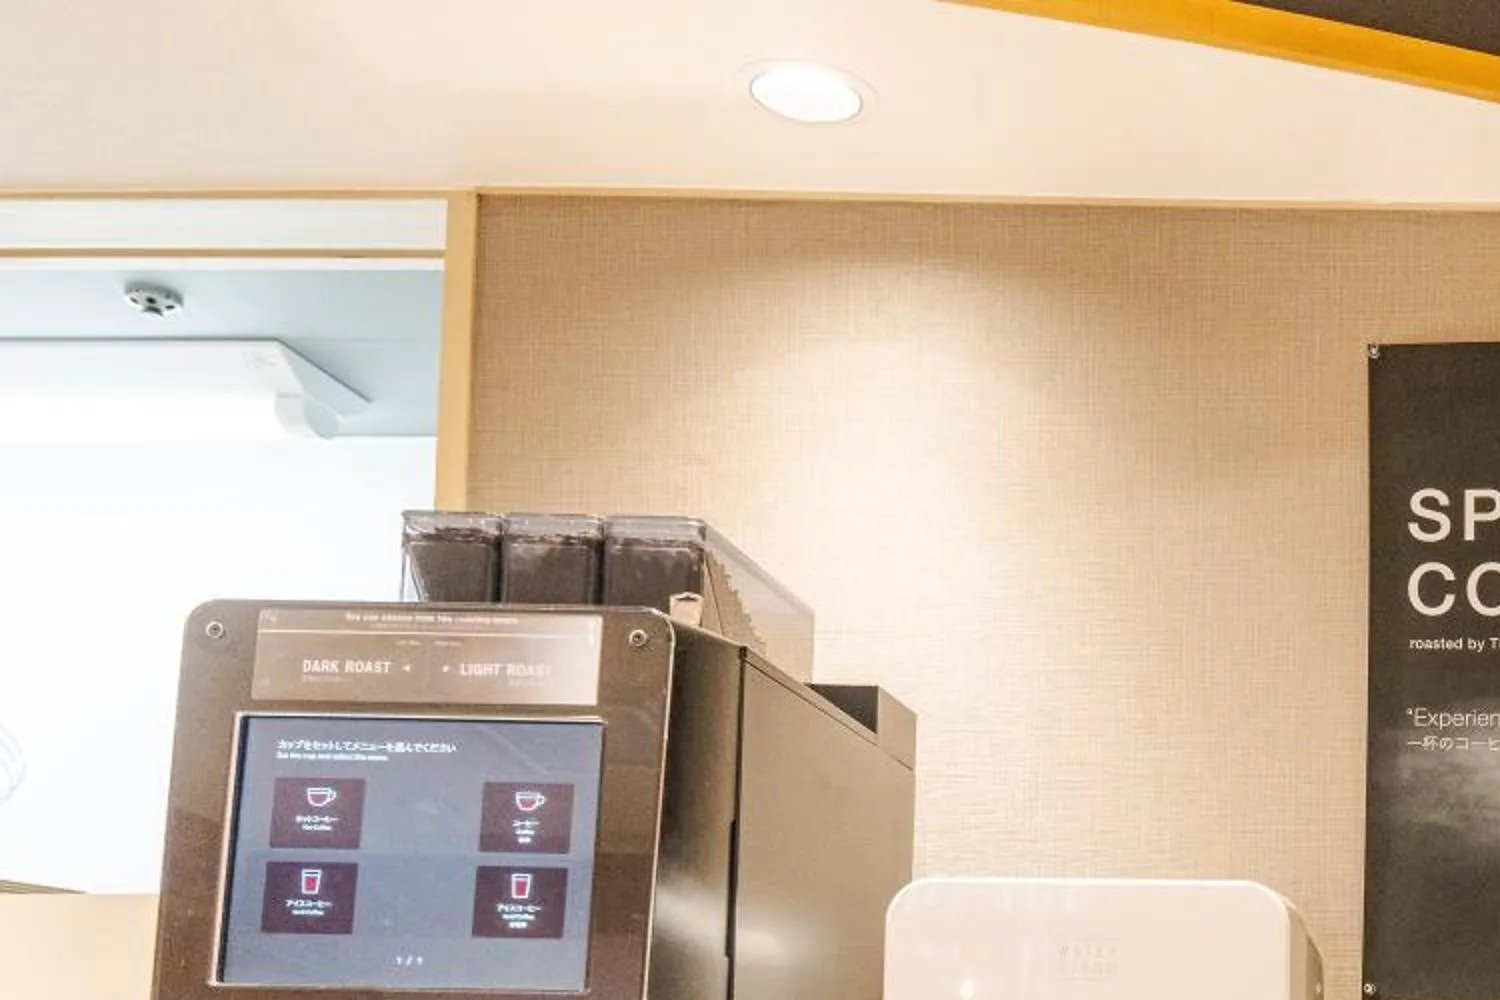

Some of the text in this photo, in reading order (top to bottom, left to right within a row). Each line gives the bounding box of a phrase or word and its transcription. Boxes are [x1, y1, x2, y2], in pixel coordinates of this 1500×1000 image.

[1409, 637, 1463, 651] roasted
[1467, 638, 1485, 653] by
[302, 658, 392, 674] DARK ROAST
[460, 662, 502, 677] LIGHT
